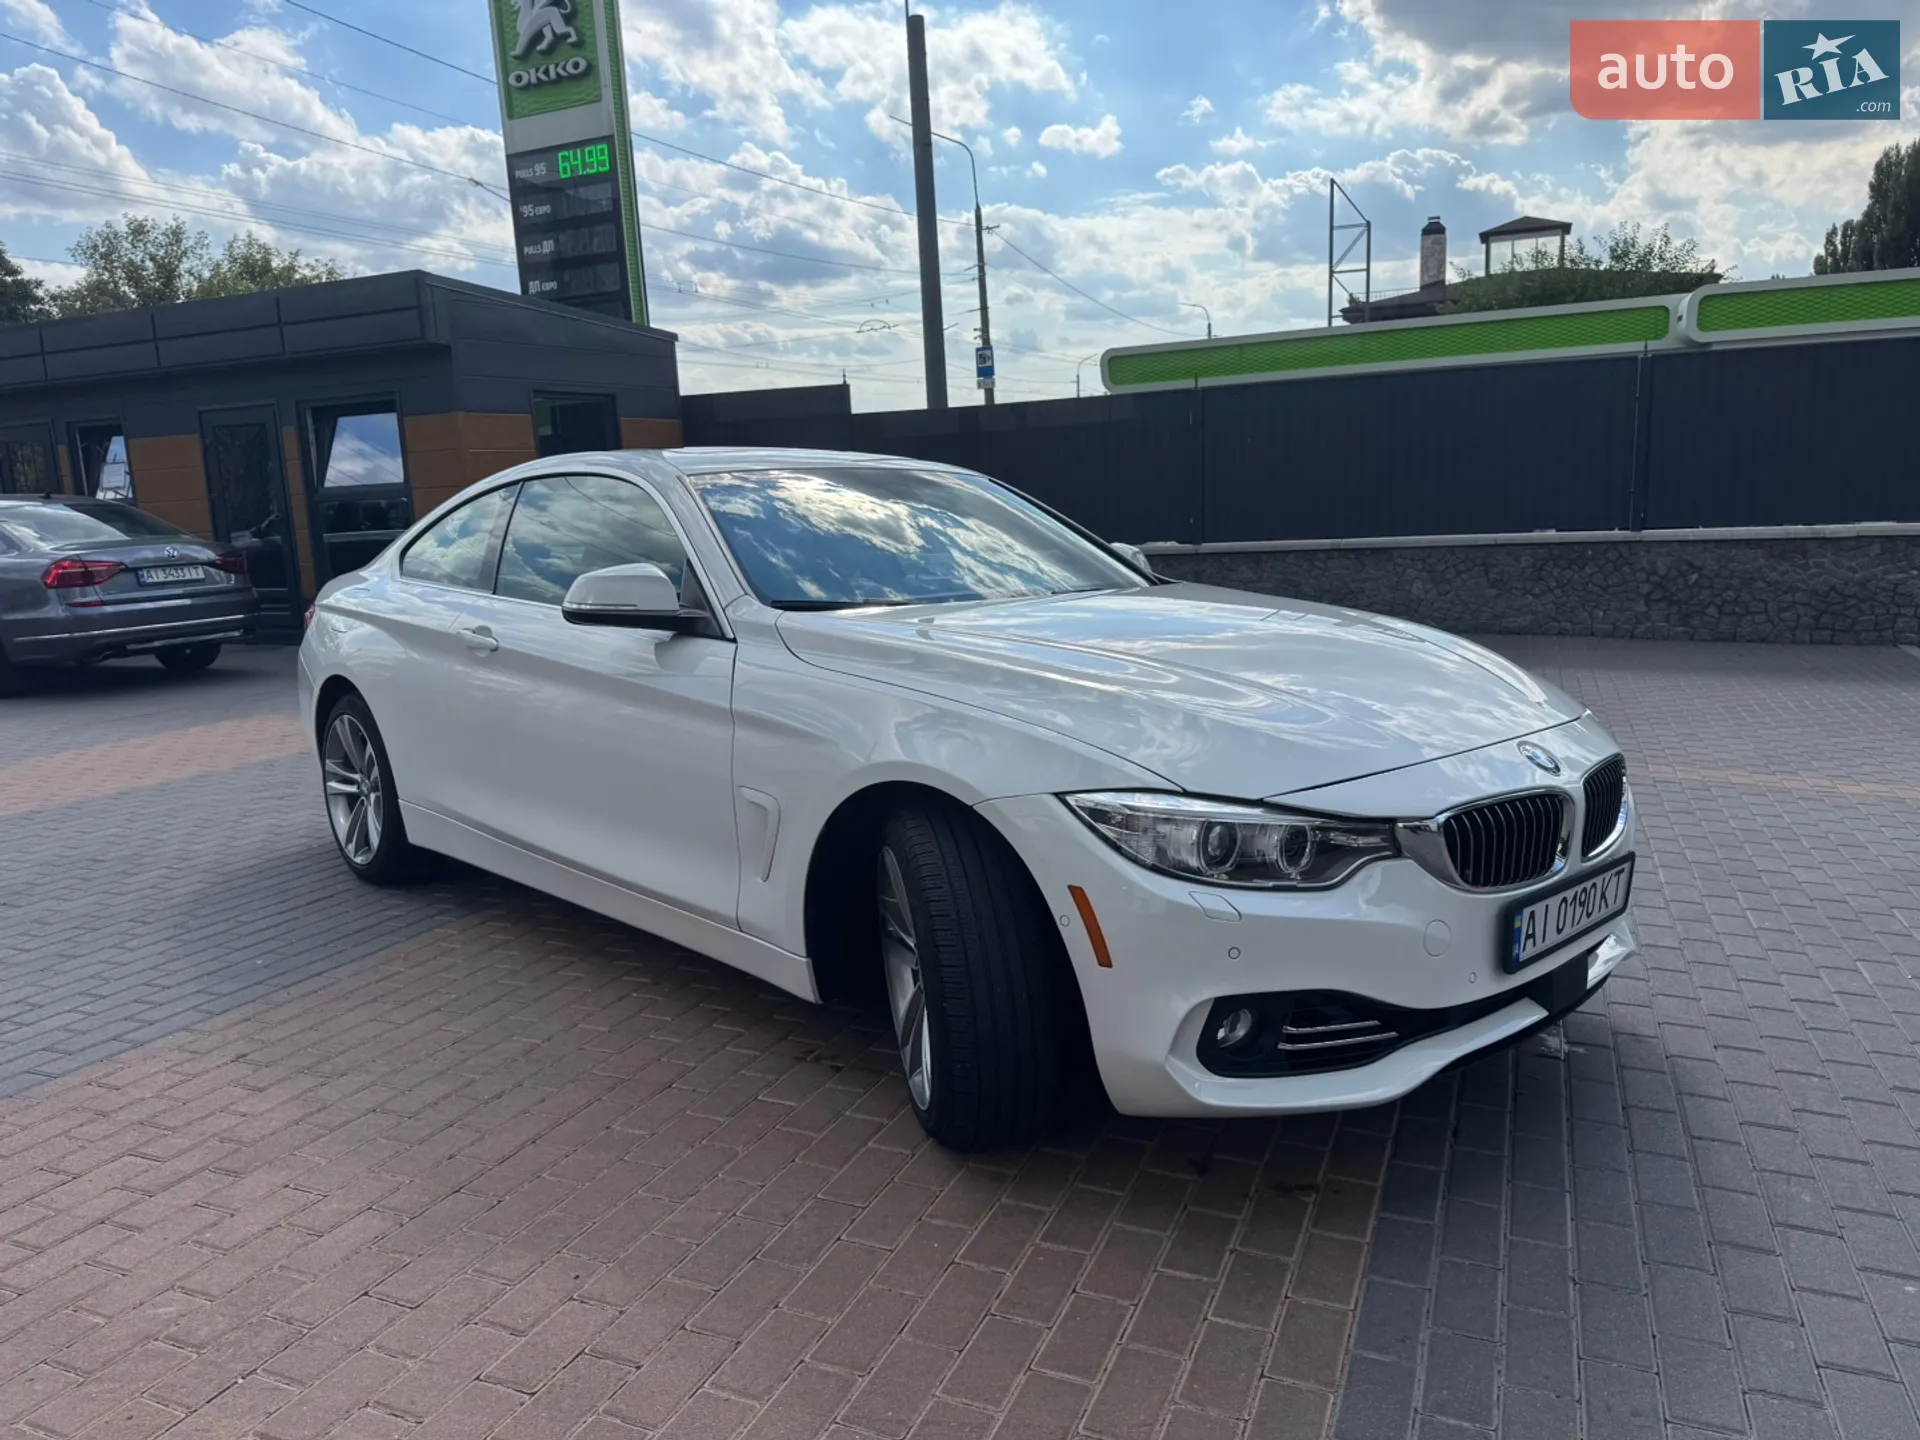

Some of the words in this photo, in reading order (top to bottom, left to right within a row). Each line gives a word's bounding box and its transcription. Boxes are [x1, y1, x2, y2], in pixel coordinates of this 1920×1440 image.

[508, 57, 587, 87] OKKO
[534, 162, 547, 176] 95
[557, 143, 610, 179] 64.99
[146, 569, 159, 580] AI
[161, 567, 186, 579] 3433
[1522, 904, 1549, 952] AI
[1556, 882, 1597, 935] 0190
[1598, 870, 1625, 913] KT
